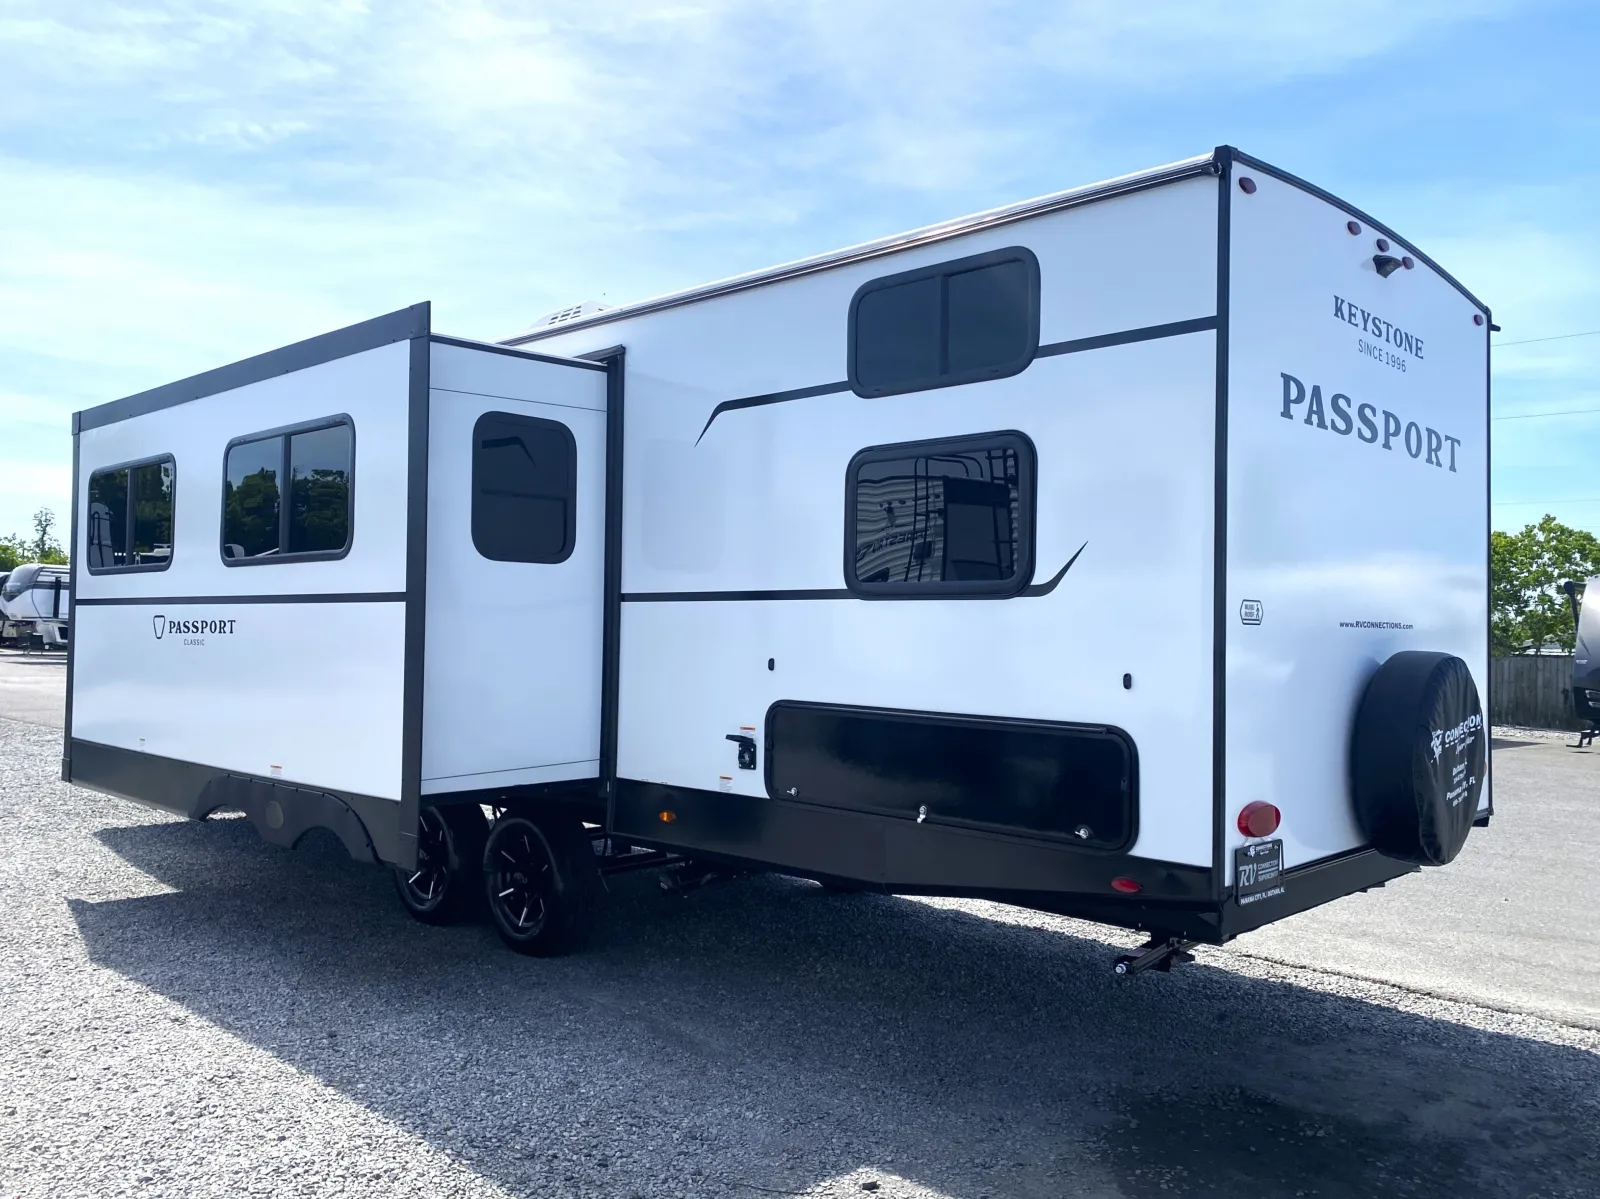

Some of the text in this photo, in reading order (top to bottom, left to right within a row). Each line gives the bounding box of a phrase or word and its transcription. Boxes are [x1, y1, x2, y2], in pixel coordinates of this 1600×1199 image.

[1333, 294, 1424, 360] KEYSTONE
[1358, 338, 1407, 373] SINCE 1996
[1280, 371, 1461, 473] PASSPORT
[168, 619, 236, 635] PASSPORT
[1339, 620, 1414, 630] www.RVCONNECTIONS.com
[183, 638, 205, 646] CLASSIC
[1239, 863, 1257, 887] RV
